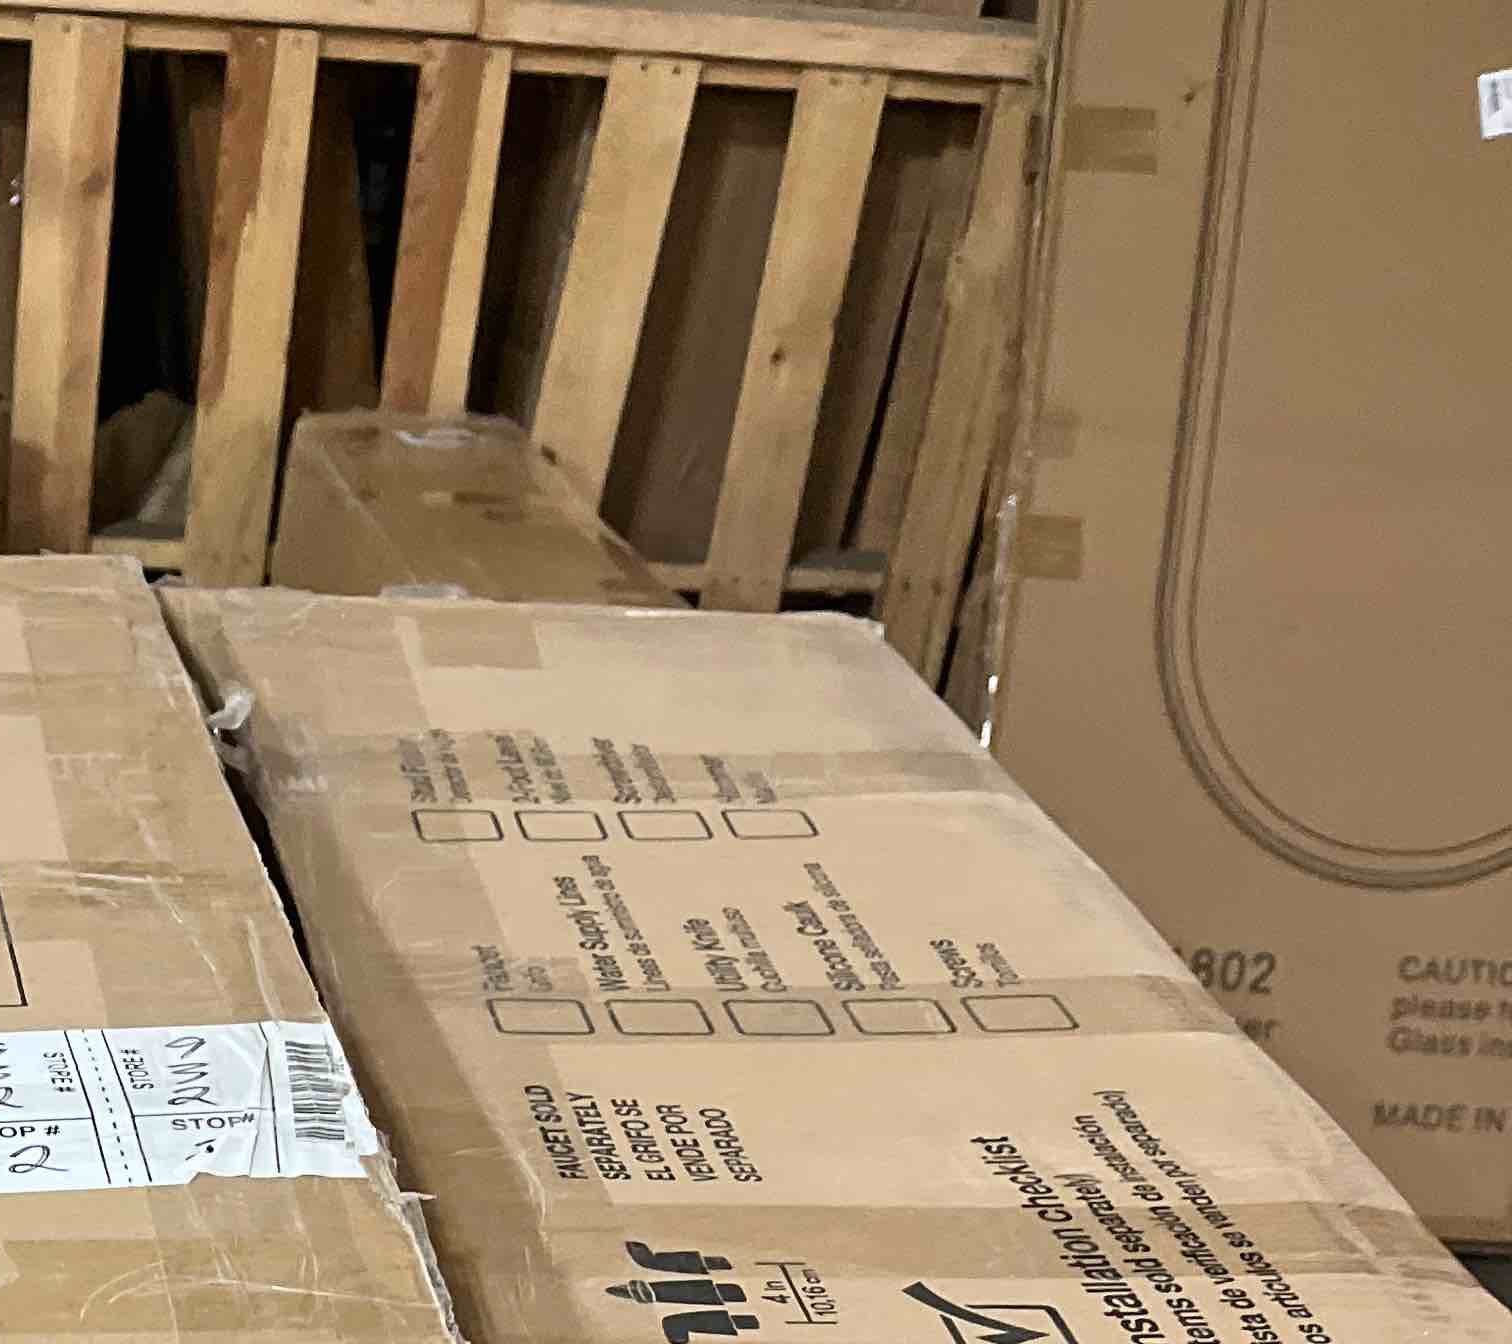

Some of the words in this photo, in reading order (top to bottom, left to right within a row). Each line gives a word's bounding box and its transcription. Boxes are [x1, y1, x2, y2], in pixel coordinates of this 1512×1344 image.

[551, 875, 586, 906] Lines
[566, 908, 610, 951] Supply
[682, 918, 725, 952] Knife
[781, 900, 828, 936] Caulk
[593, 953, 630, 991] Water
[704, 953, 749, 992] Utility
[812, 939, 866, 992] Silicone
[926, 939, 983, 989] Screws
[1174, 946, 1277, 994] 802
[524, 1084, 562, 1123] SOLD
[611, 1098, 643, 1116] SE
[654, 1104, 690, 1135] POR
[1372, 1102, 1467, 1131] MADE
[1474, 1105, 1506, 1132] IN
[565, 1091, 632, 1181] SEPARATELY
[620, 1119, 663, 1164] GRIFO
[1093, 1090, 1162, 1157] separado)
[8, 1145, 69, 1173] 2
[540, 1126, 588, 1180] FAUCET
[669, 1138, 719, 1182] VENDE
[698, 1108, 762, 1182] SEPARADO
[645, 1166, 676, 1182] EL
[970, 1136, 1073, 1222] checklist
[1153, 1158, 1193, 1179] por
[1133, 1184, 1164, 1202] de
[1176, 1179, 1233, 1229] venden
[1054, 1173, 1151, 1253] separately)
[1224, 1231, 1255, 1249] se
[1125, 1257, 1184, 1294] sold
[1219, 1288, 1255, 1310] de
